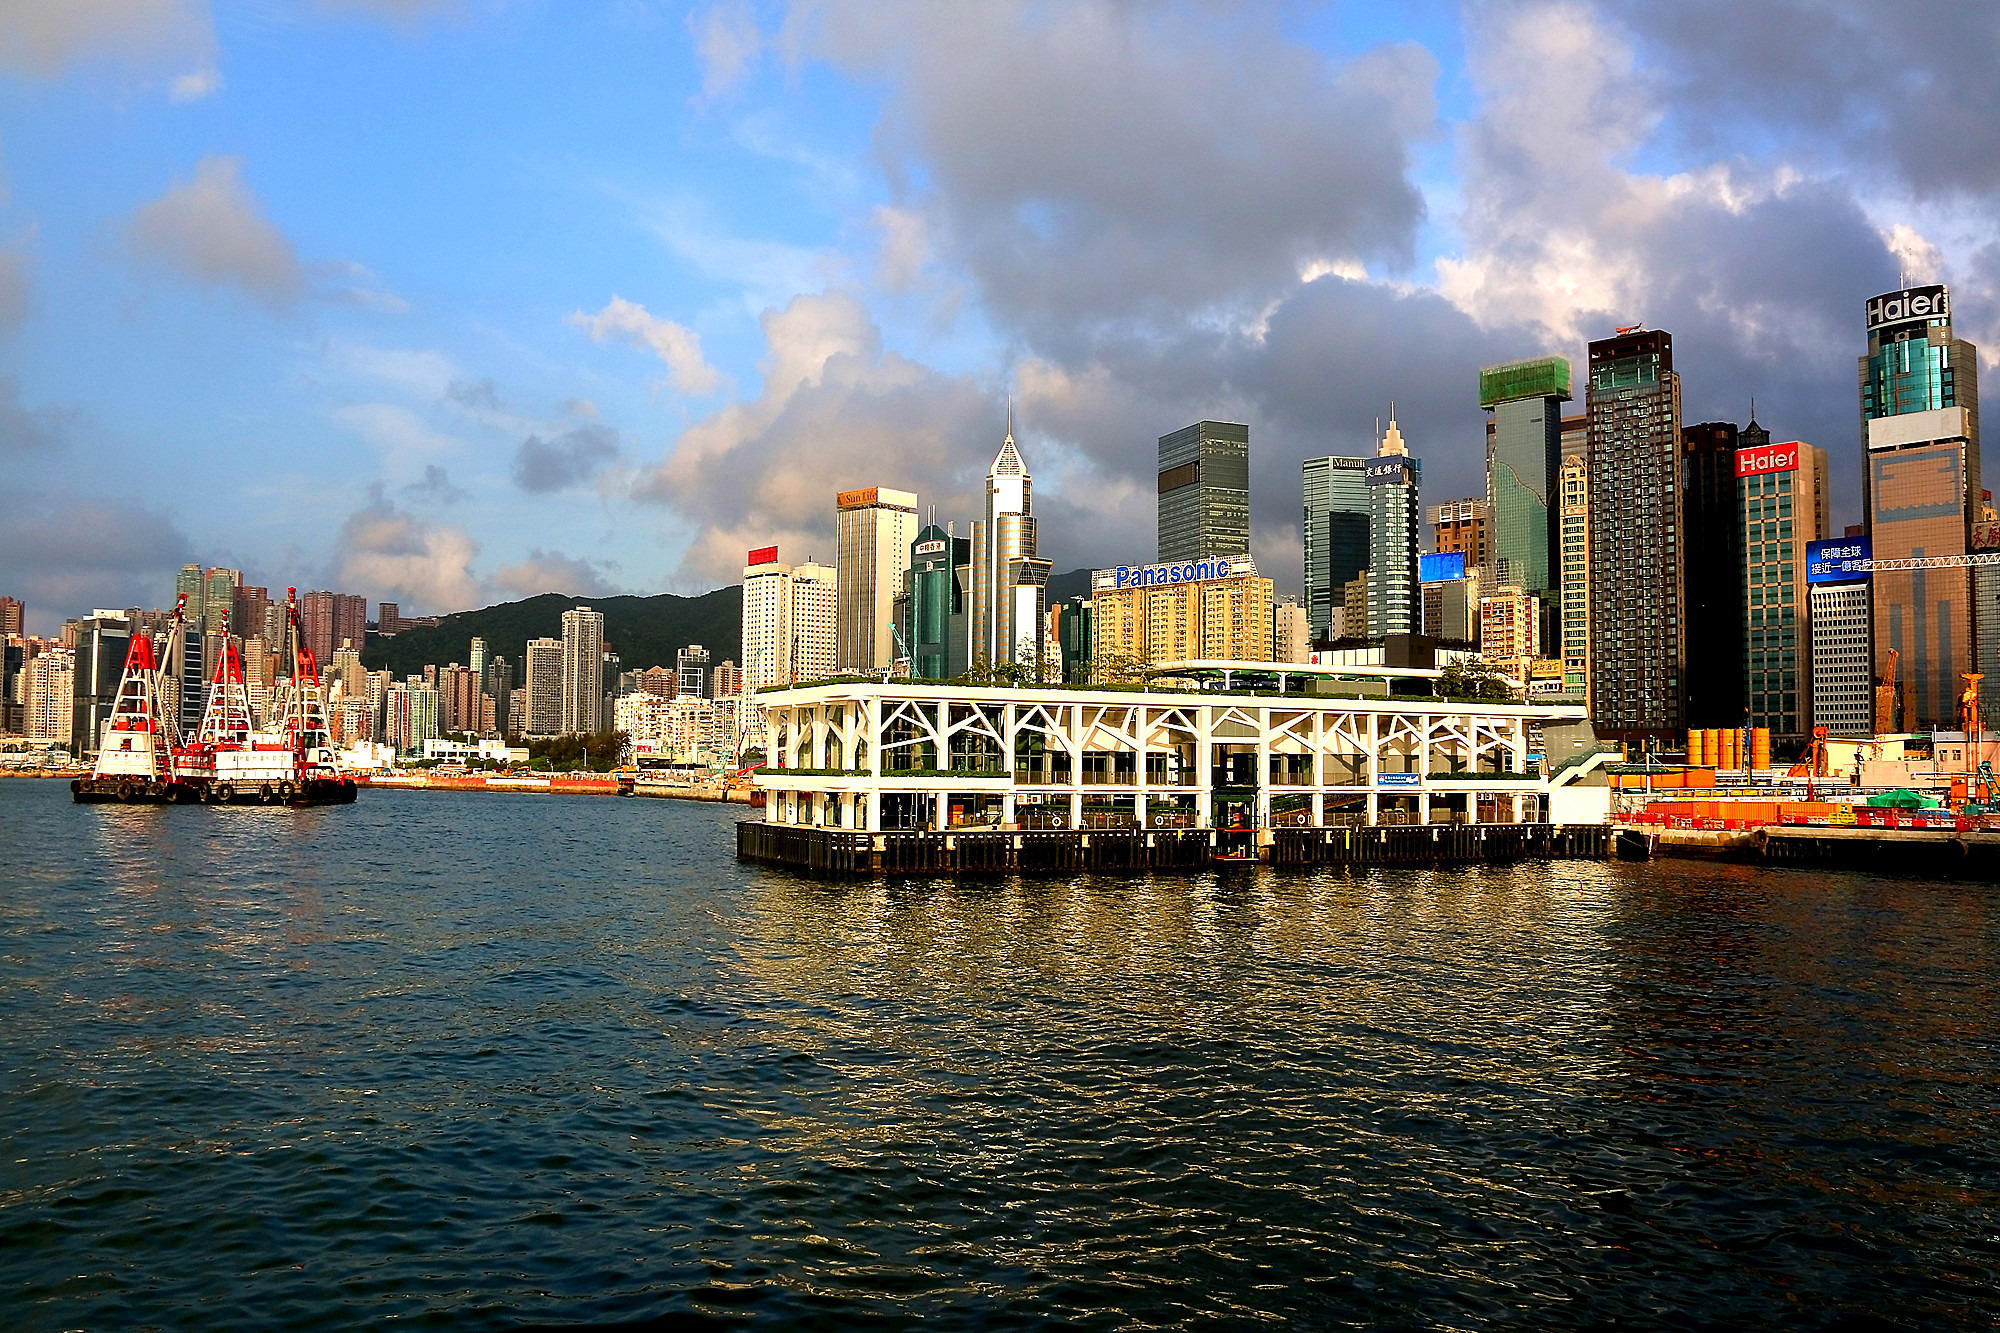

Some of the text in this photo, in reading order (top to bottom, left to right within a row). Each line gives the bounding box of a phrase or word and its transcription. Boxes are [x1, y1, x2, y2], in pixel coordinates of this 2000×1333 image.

[1867, 291, 1943, 326] Haier
[1740, 450, 1796, 473] Haier
[845, 489, 878, 504] Sun Life
[1820, 545, 1862, 560] 保障全球
[1115, 554, 1230, 590] Panasonic
